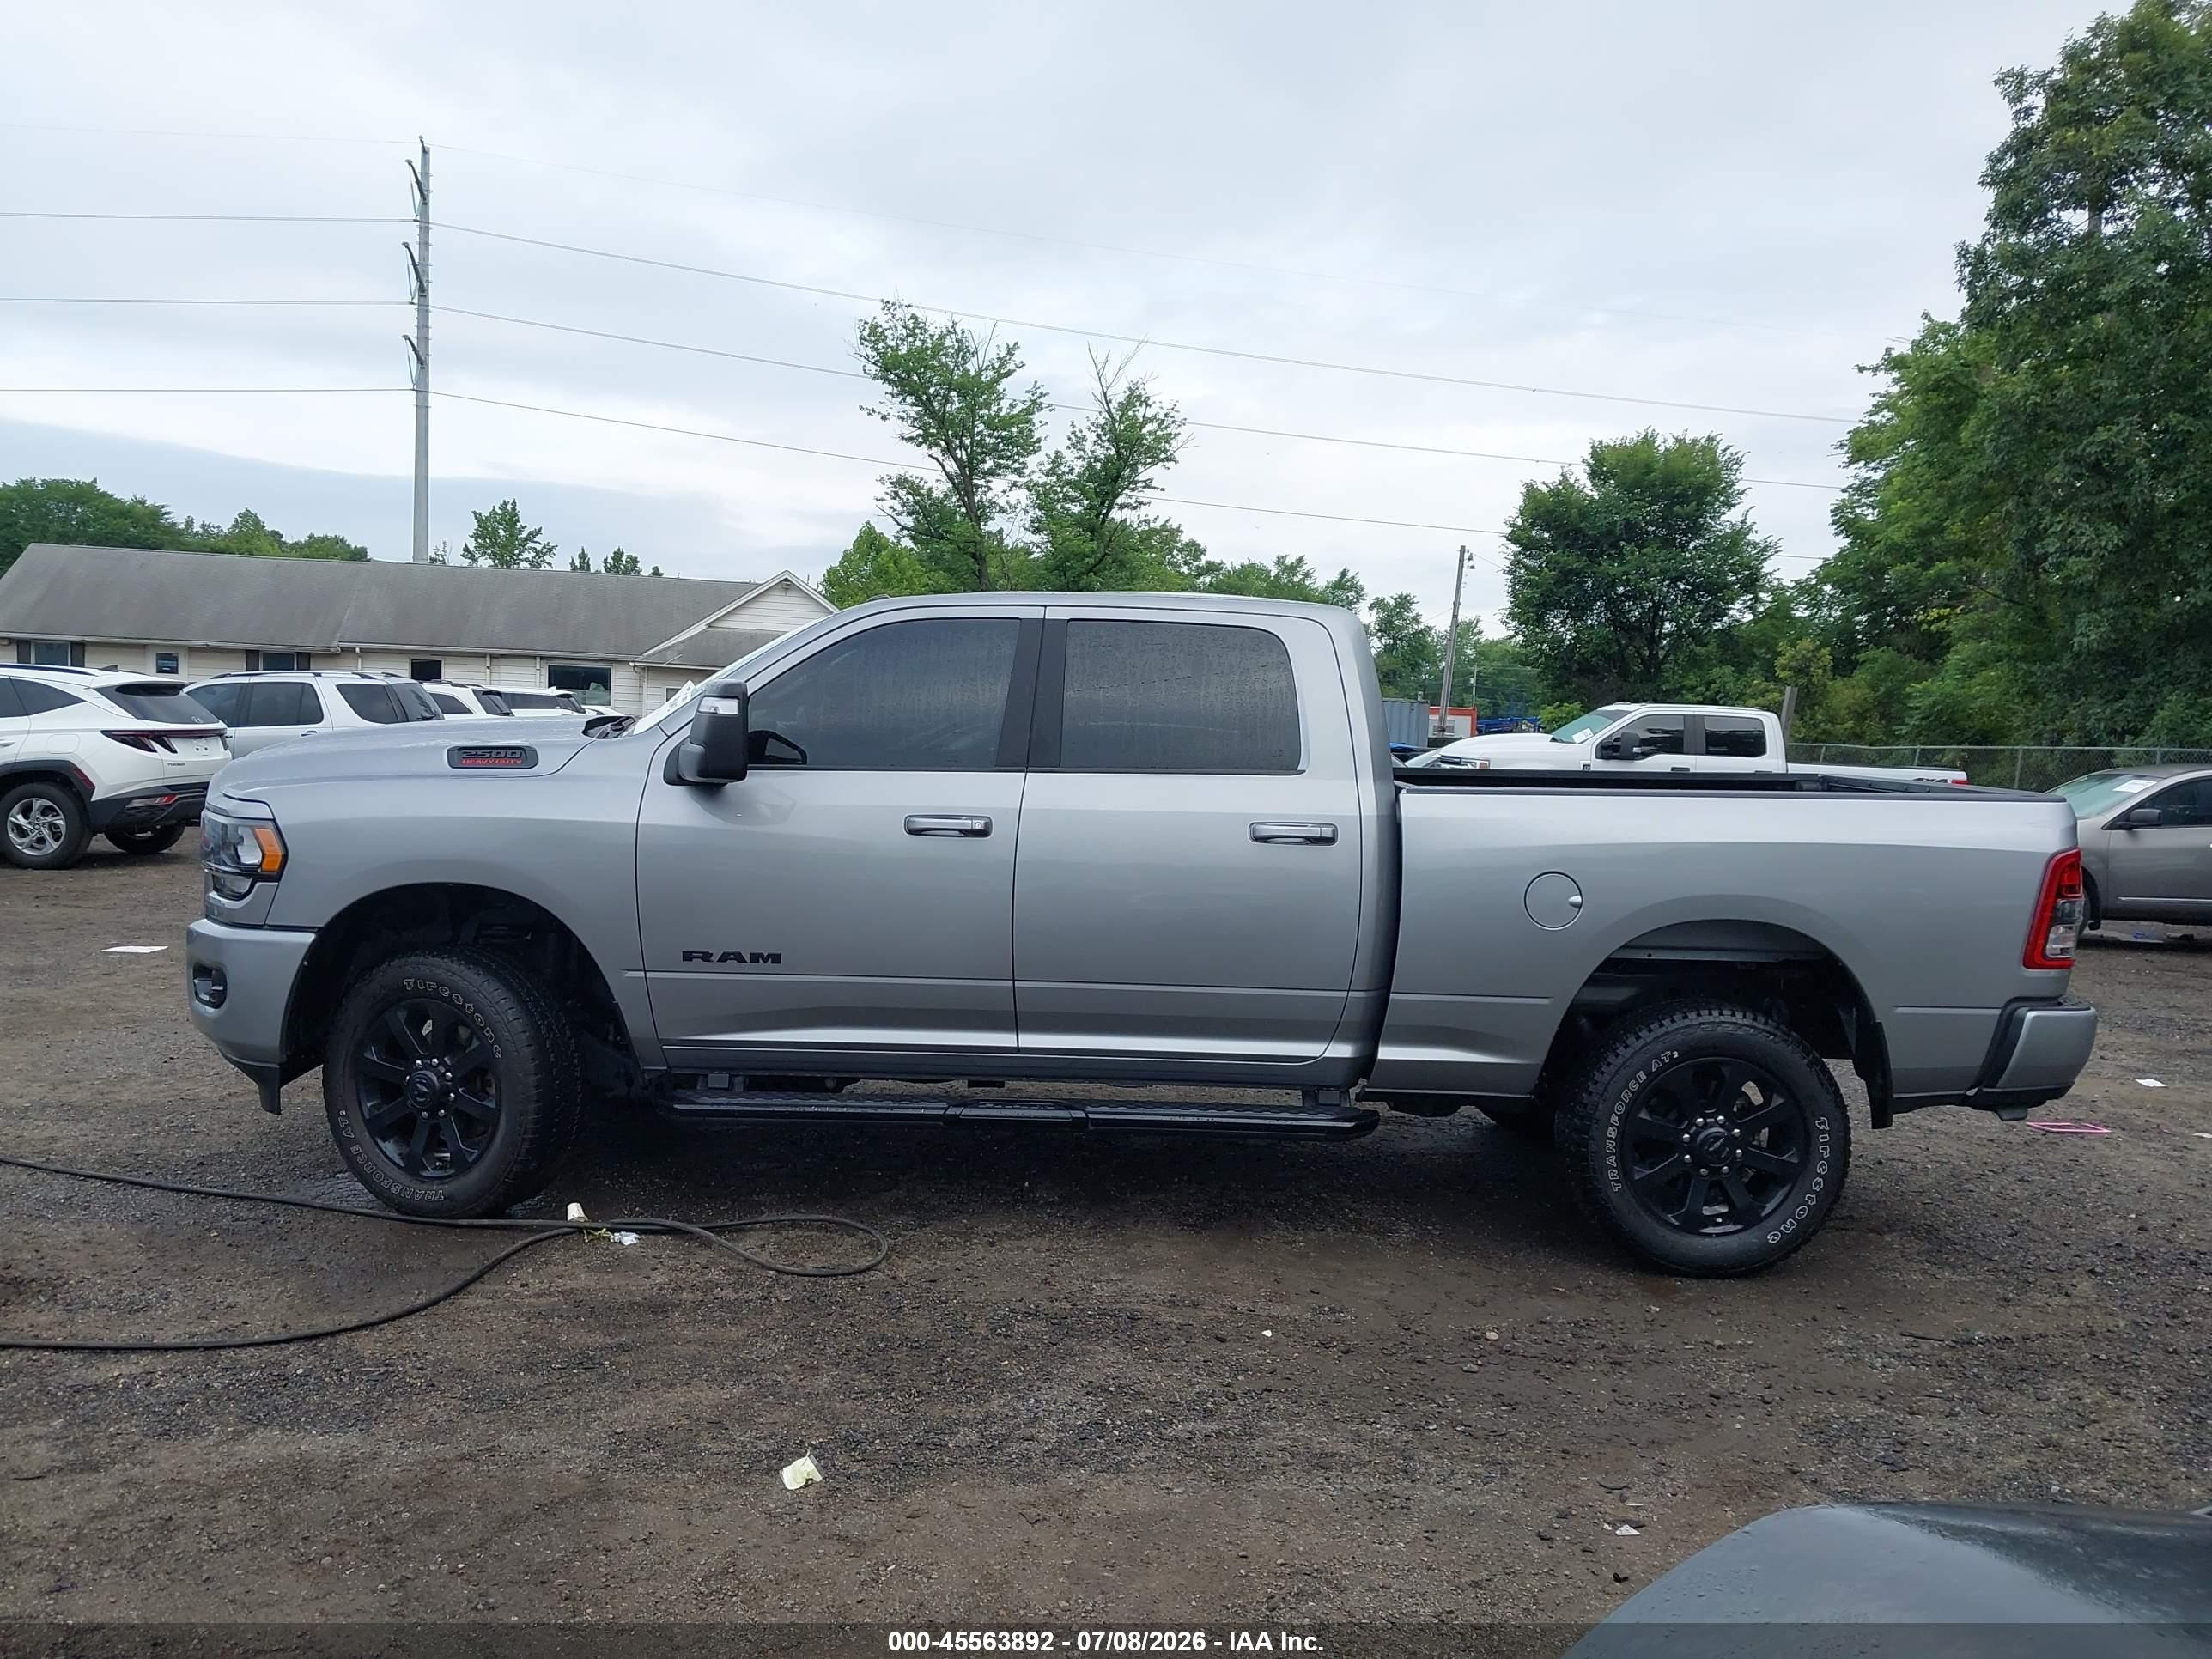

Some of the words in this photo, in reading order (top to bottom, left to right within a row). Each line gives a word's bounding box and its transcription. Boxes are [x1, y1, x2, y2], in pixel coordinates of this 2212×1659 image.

[461, 749, 523, 758] 2500
[682, 951, 781, 964] RAM
[1605, 1070, 1648, 1192] TRANSFORCE
[350, 1145, 445, 1201] TRANSFORCE
